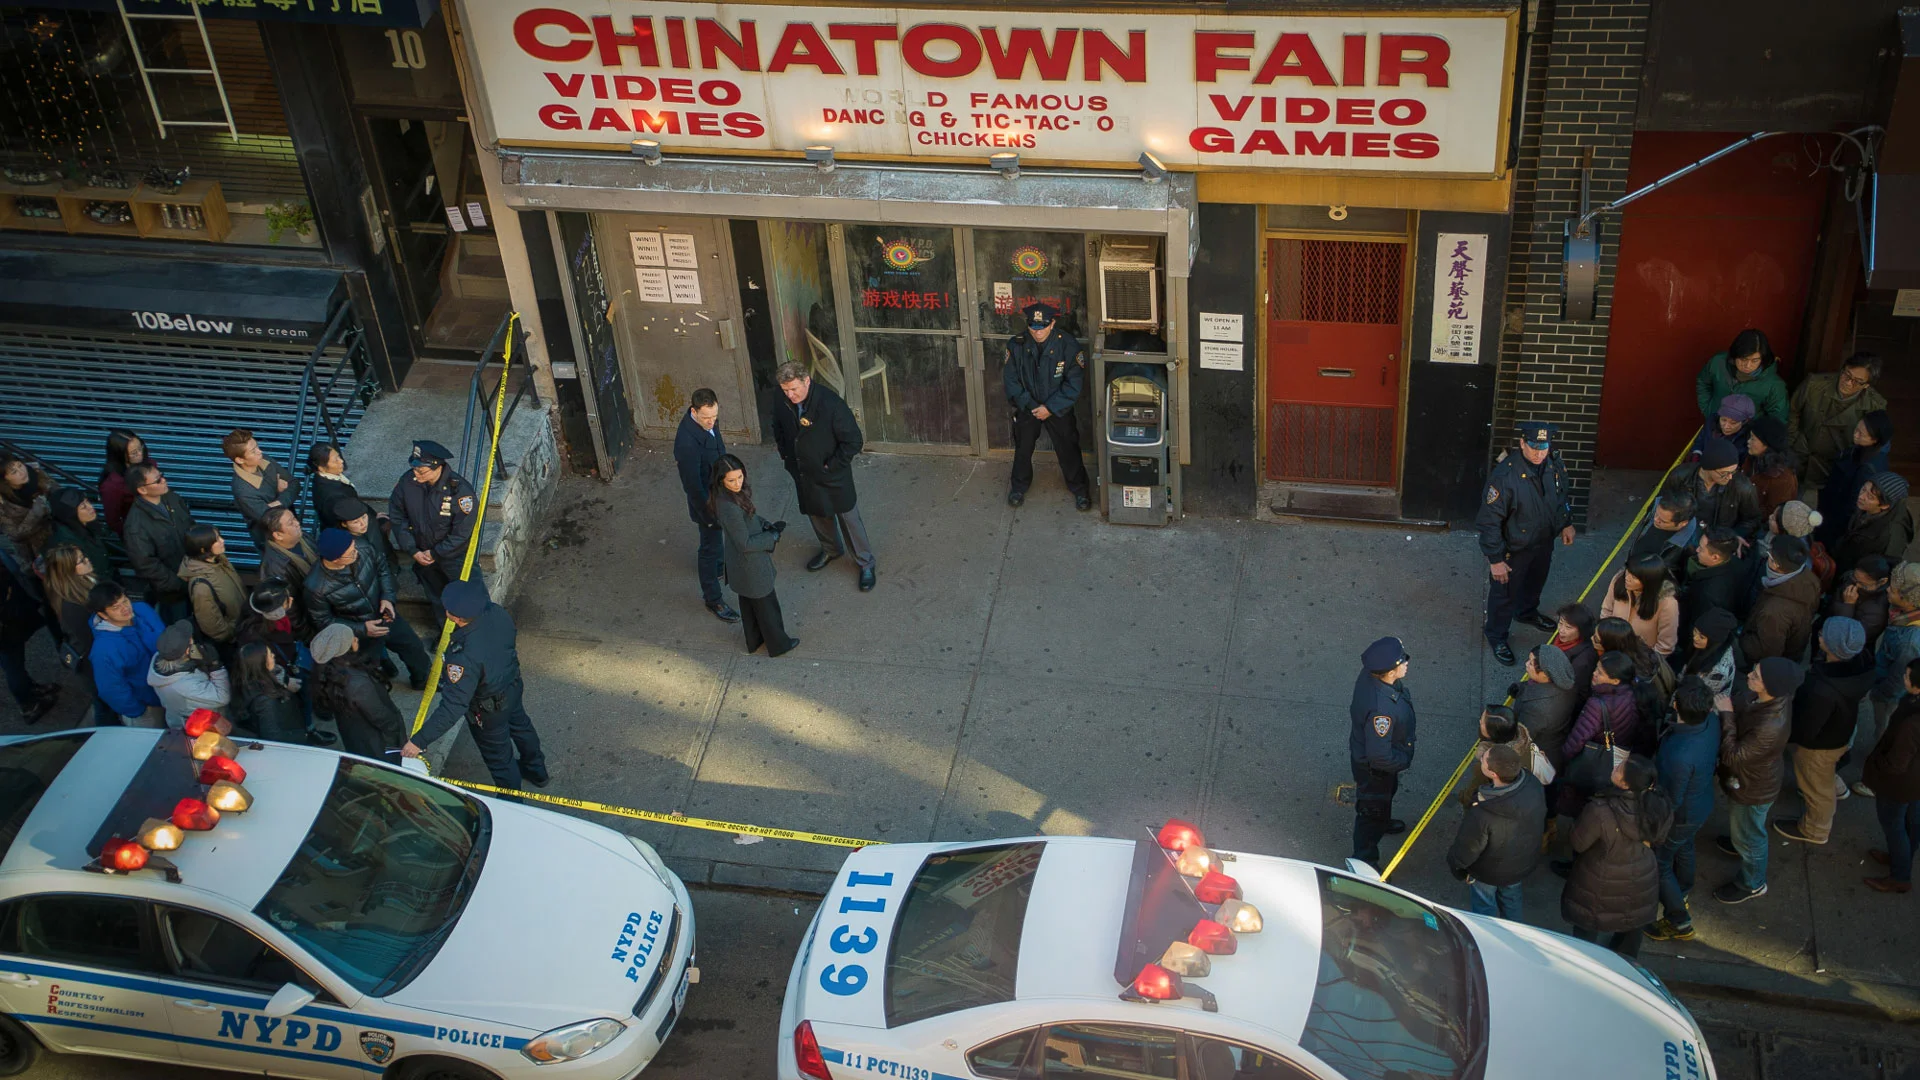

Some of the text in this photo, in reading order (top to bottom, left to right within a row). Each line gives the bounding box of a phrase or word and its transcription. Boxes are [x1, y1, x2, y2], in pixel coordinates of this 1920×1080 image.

[384, 29, 426, 69] 10
[513, 8, 1451, 88] CHINATOWN FAIR
[543, 72, 742, 106] VIDEO
[970, 92, 1108, 111] FAMOUS
[538, 104, 765, 138] GAMES
[940, 111, 957, 128] &
[1208, 94, 1427, 126] VIDEO
[917, 131, 1036, 148] CHICKENS
[1189, 127, 1440, 159] GAMES
[132, 311, 308, 337] 10Below ice cream
[611, 912, 642, 963] NYPD
[625, 910, 663, 983] POLICE
[820, 871, 894, 996] 1139
[48, 995, 145, 1018] PROFESSIONALISM
[50, 984, 104, 1001] COURTESY
[47, 1005, 96, 1020] RESPECT
[217, 1010, 342, 1052] NYPD
[436, 1026, 502, 1048] POLICE
[846, 1052, 862, 1069] 11
